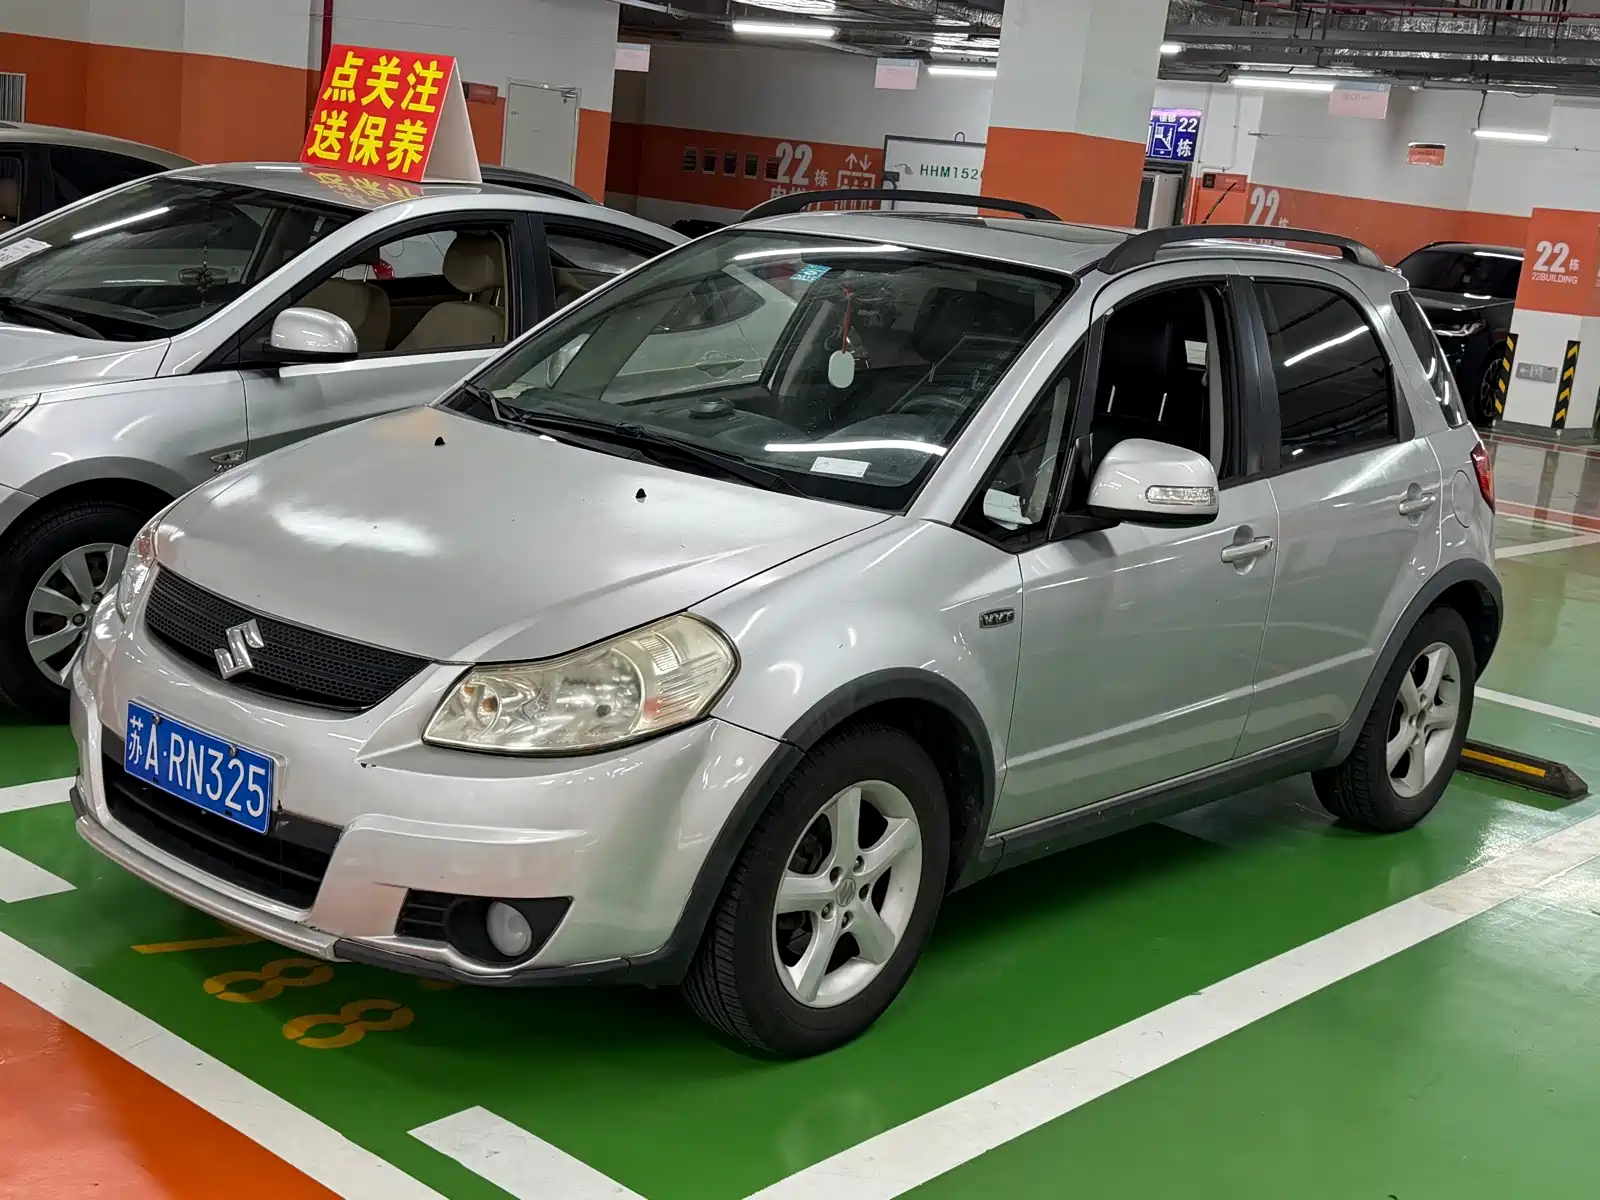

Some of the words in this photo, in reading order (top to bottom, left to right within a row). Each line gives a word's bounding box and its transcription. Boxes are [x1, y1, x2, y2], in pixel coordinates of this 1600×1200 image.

[322, 51, 444, 113] 点关注
[1177, 117, 1198, 133] 22
[307, 109, 428, 174] 送保养
[1176, 138, 1193, 157] 栋
[920, 163, 983, 180] HHM152
[1531, 271, 1578, 285] 22BUILDING
[128, 715, 266, 818] 苏A·RN325
